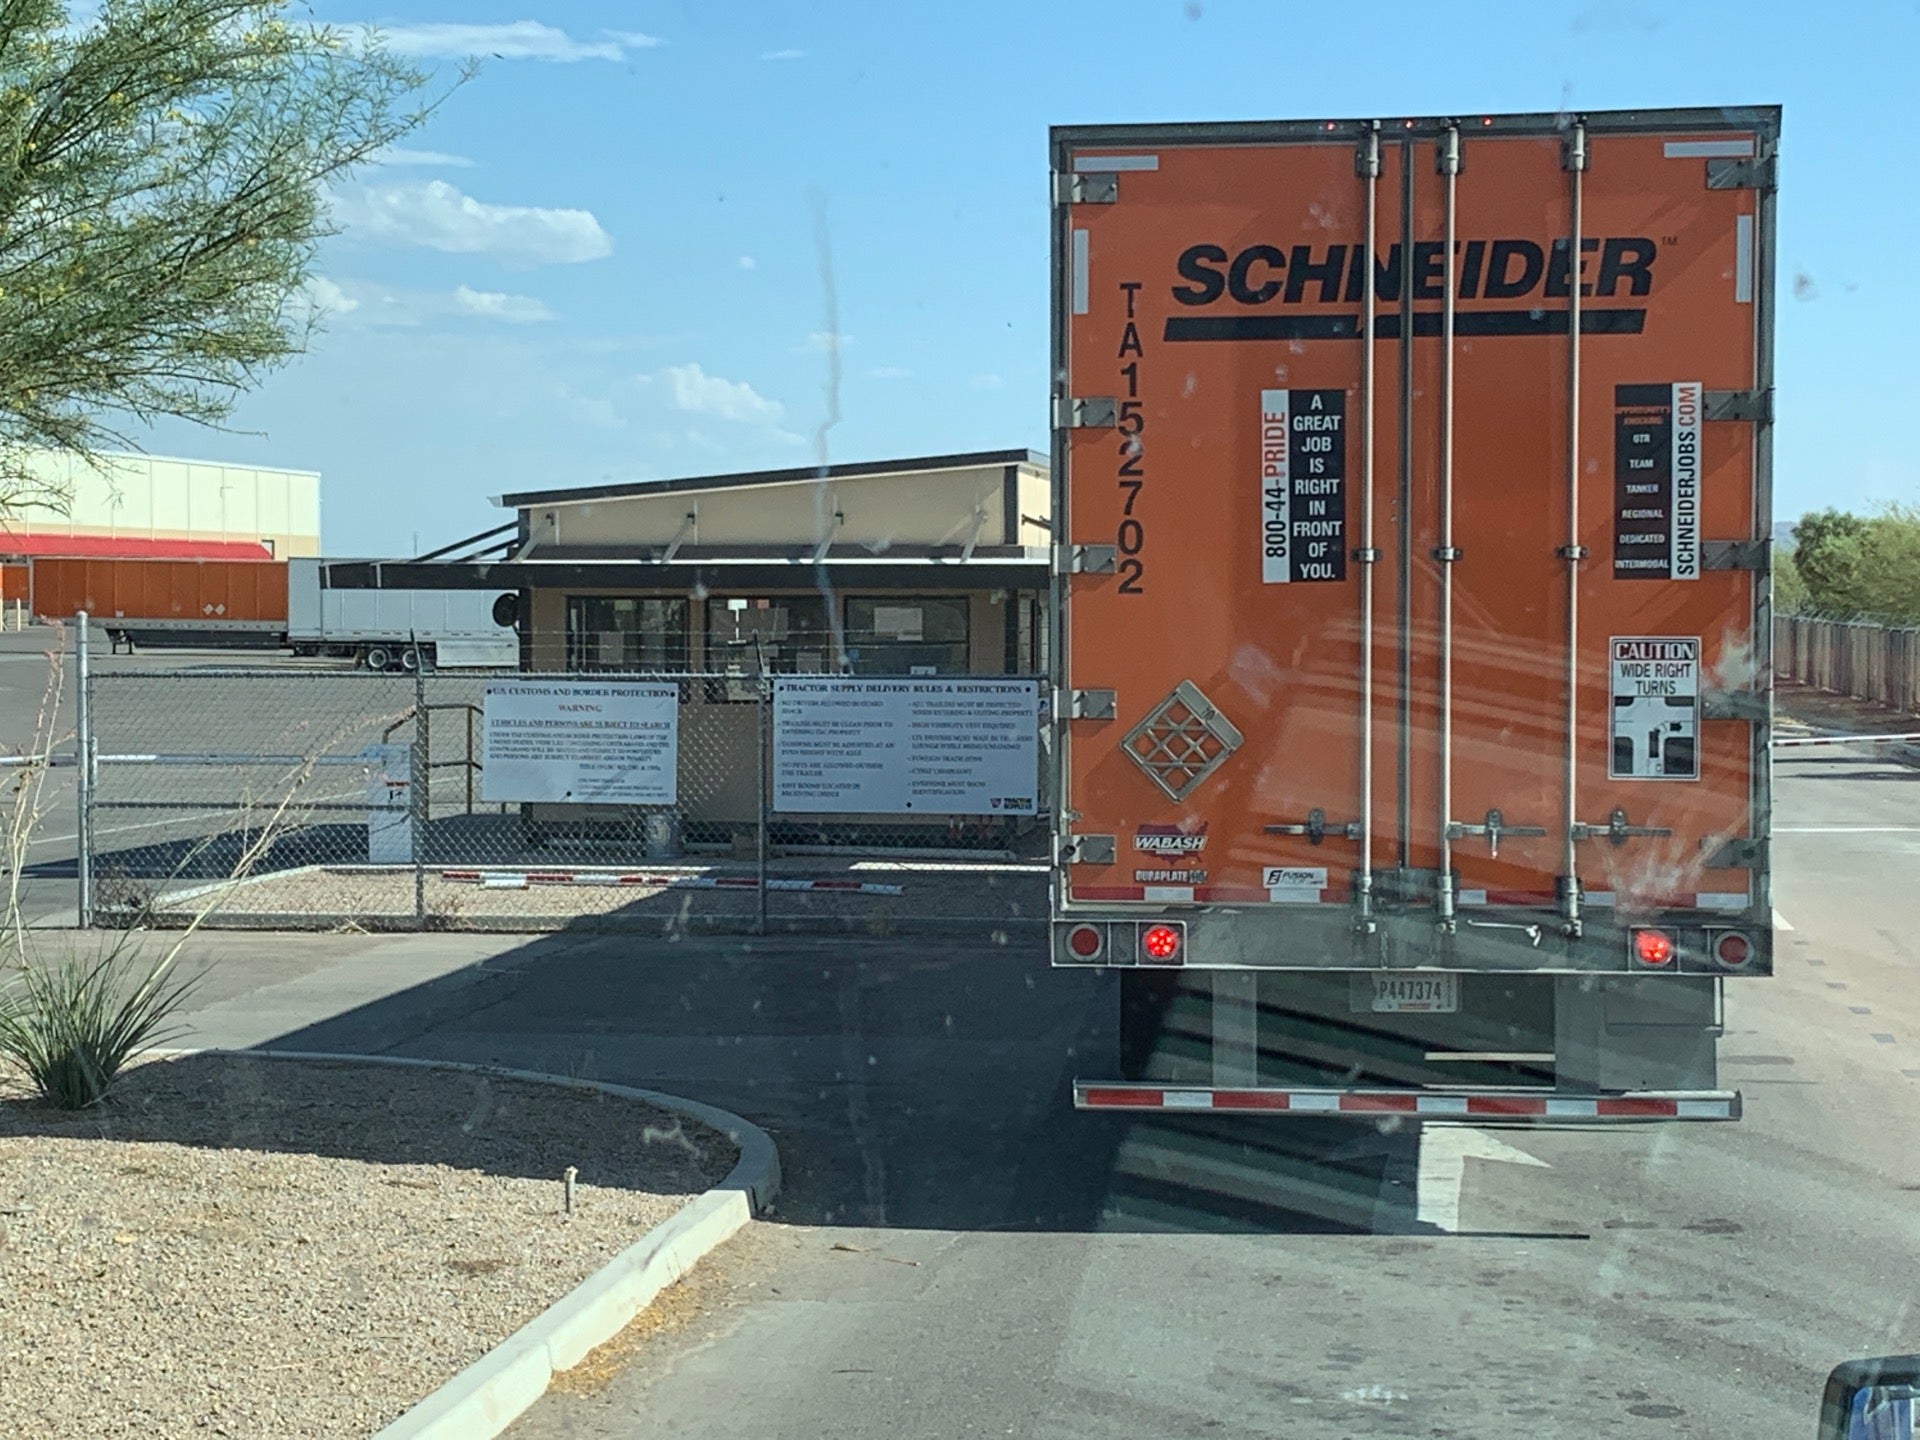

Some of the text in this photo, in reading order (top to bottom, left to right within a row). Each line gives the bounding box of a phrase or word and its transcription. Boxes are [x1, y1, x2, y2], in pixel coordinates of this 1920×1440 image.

[1171, 238, 1658, 304] SCHNEIDER
[1310, 394, 1323, 411] A
[1292, 415, 1342, 431] GREAT
[1117, 282, 1145, 594] TA152702
[1300, 436, 1332, 453] JOB
[1309, 457, 1325, 474] IS
[1629, 459, 1655, 469] TEAM
[1263, 411, 1287, 559] 800-44-PRIDE
[1294, 478, 1341, 495] RIGHT
[1676, 385, 1697, 576] SCHNEIDERJOBS.COM
[1625, 484, 1659, 494] TANKER
[1308, 500, 1326, 516] IN
[1621, 509, 1664, 519] REGIONAL
[1292, 520, 1343, 537] FRONT
[1619, 533, 1666, 544] DEDICATED
[1308, 542, 1328, 558] OF
[1300, 562, 1336, 579] YOU.
[1614, 559, 1670, 569] INTERMODAL
[1615, 642, 1696, 660] CAUTION
[1620, 662, 1692, 678] WIDE RIGHT
[509, 688, 551, 696] CUSTOMS
[553, 688, 571, 697] AND
[573, 688, 608, 697] BORDER
[611, 689, 670, 697] PROTECTION
[786, 684, 1022, 694] TRACTOR SUPPLY DELIVERY RULES & RESTRICTIONS
[1635, 680, 1677, 695] TURNS
[558, 704, 602, 712] WARNING
[1135, 836, 1206, 849] WABASH
[1135, 870, 1188, 882] DURAPLATE
[1379, 981, 1441, 1000] P447374
